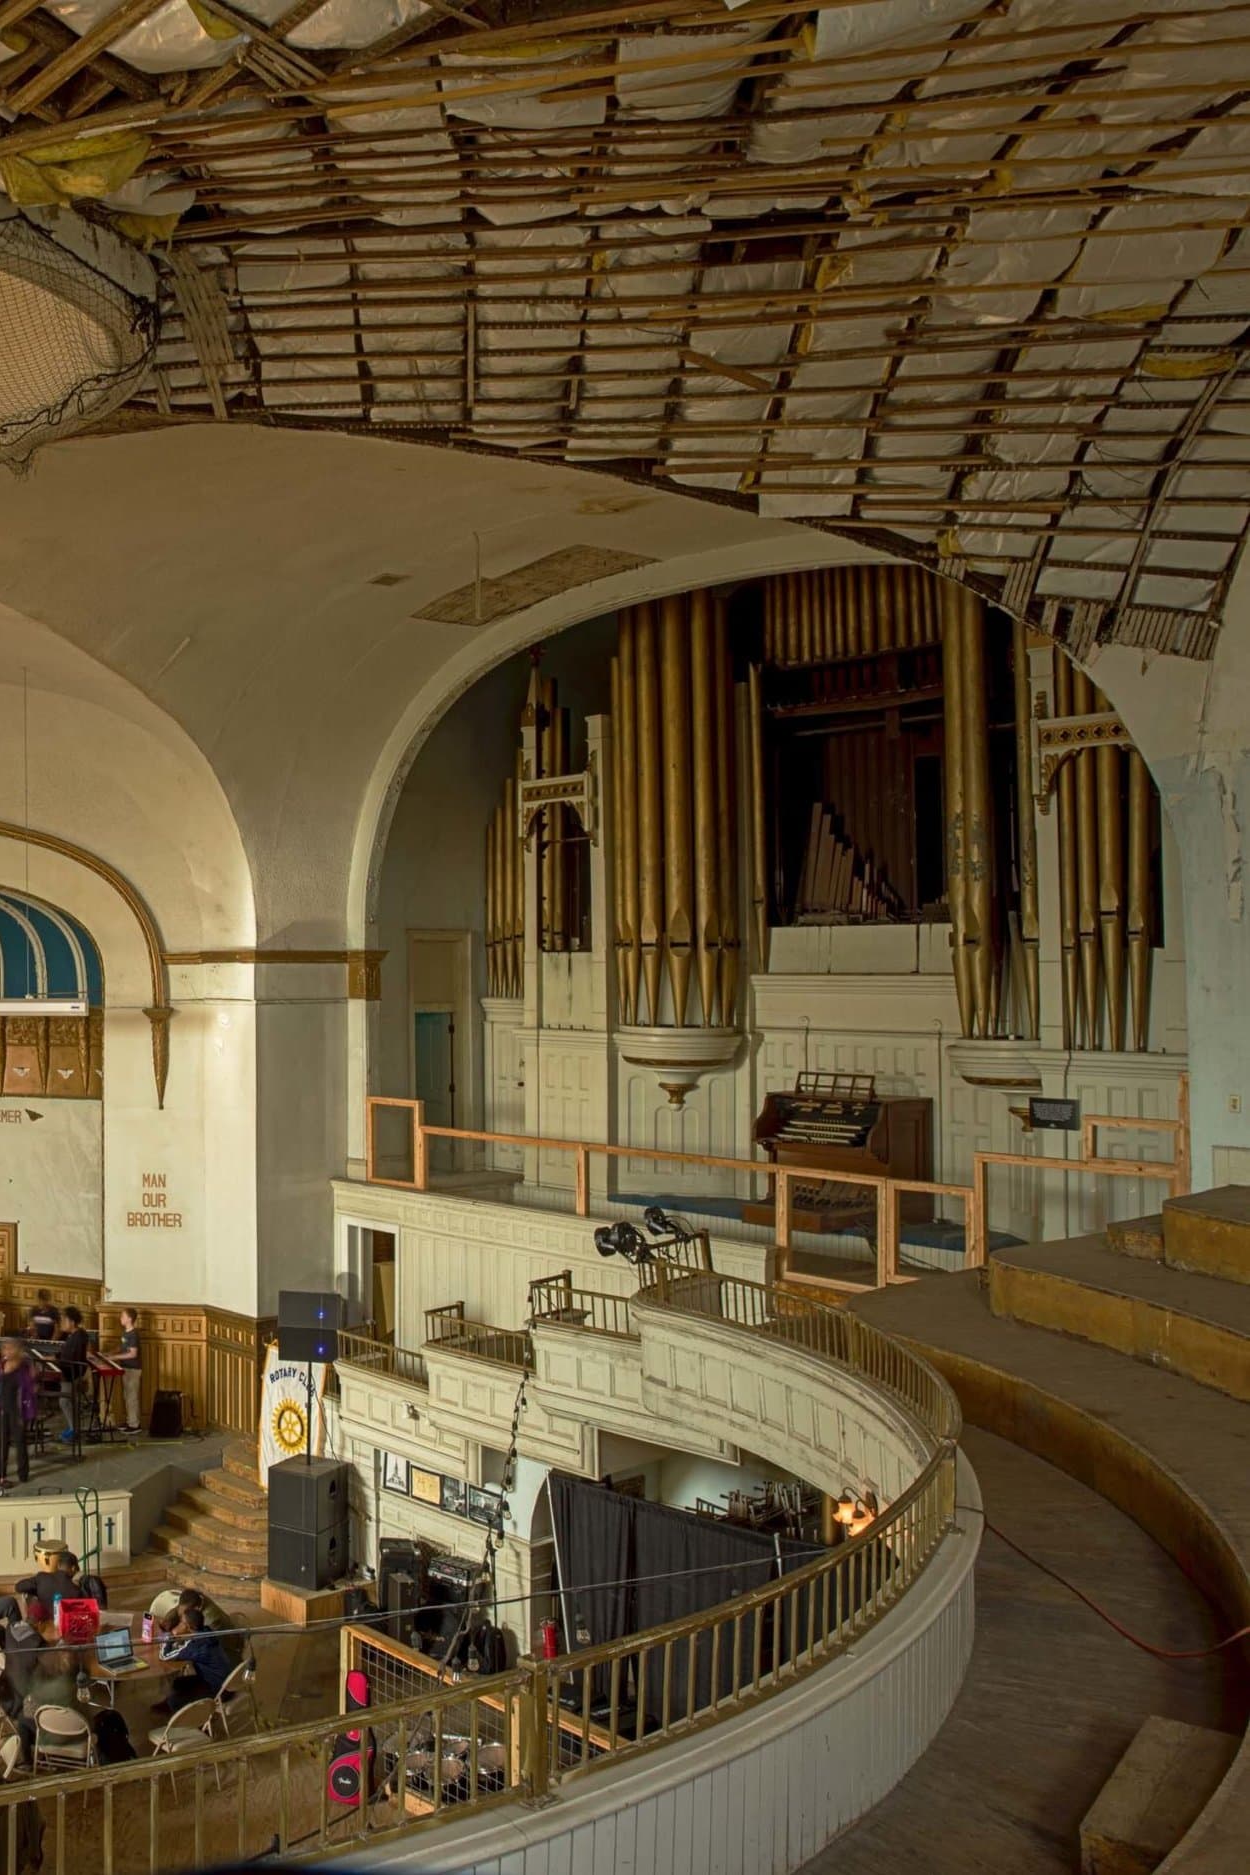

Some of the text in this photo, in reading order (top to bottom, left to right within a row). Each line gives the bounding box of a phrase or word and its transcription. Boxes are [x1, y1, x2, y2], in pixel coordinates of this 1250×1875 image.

[142, 1173, 167, 1188] MAN
[142, 1192, 167, 1208] OUR
[127, 1211, 182, 1228] BROTHER
[269, 1367, 298, 1384] ROTARY
